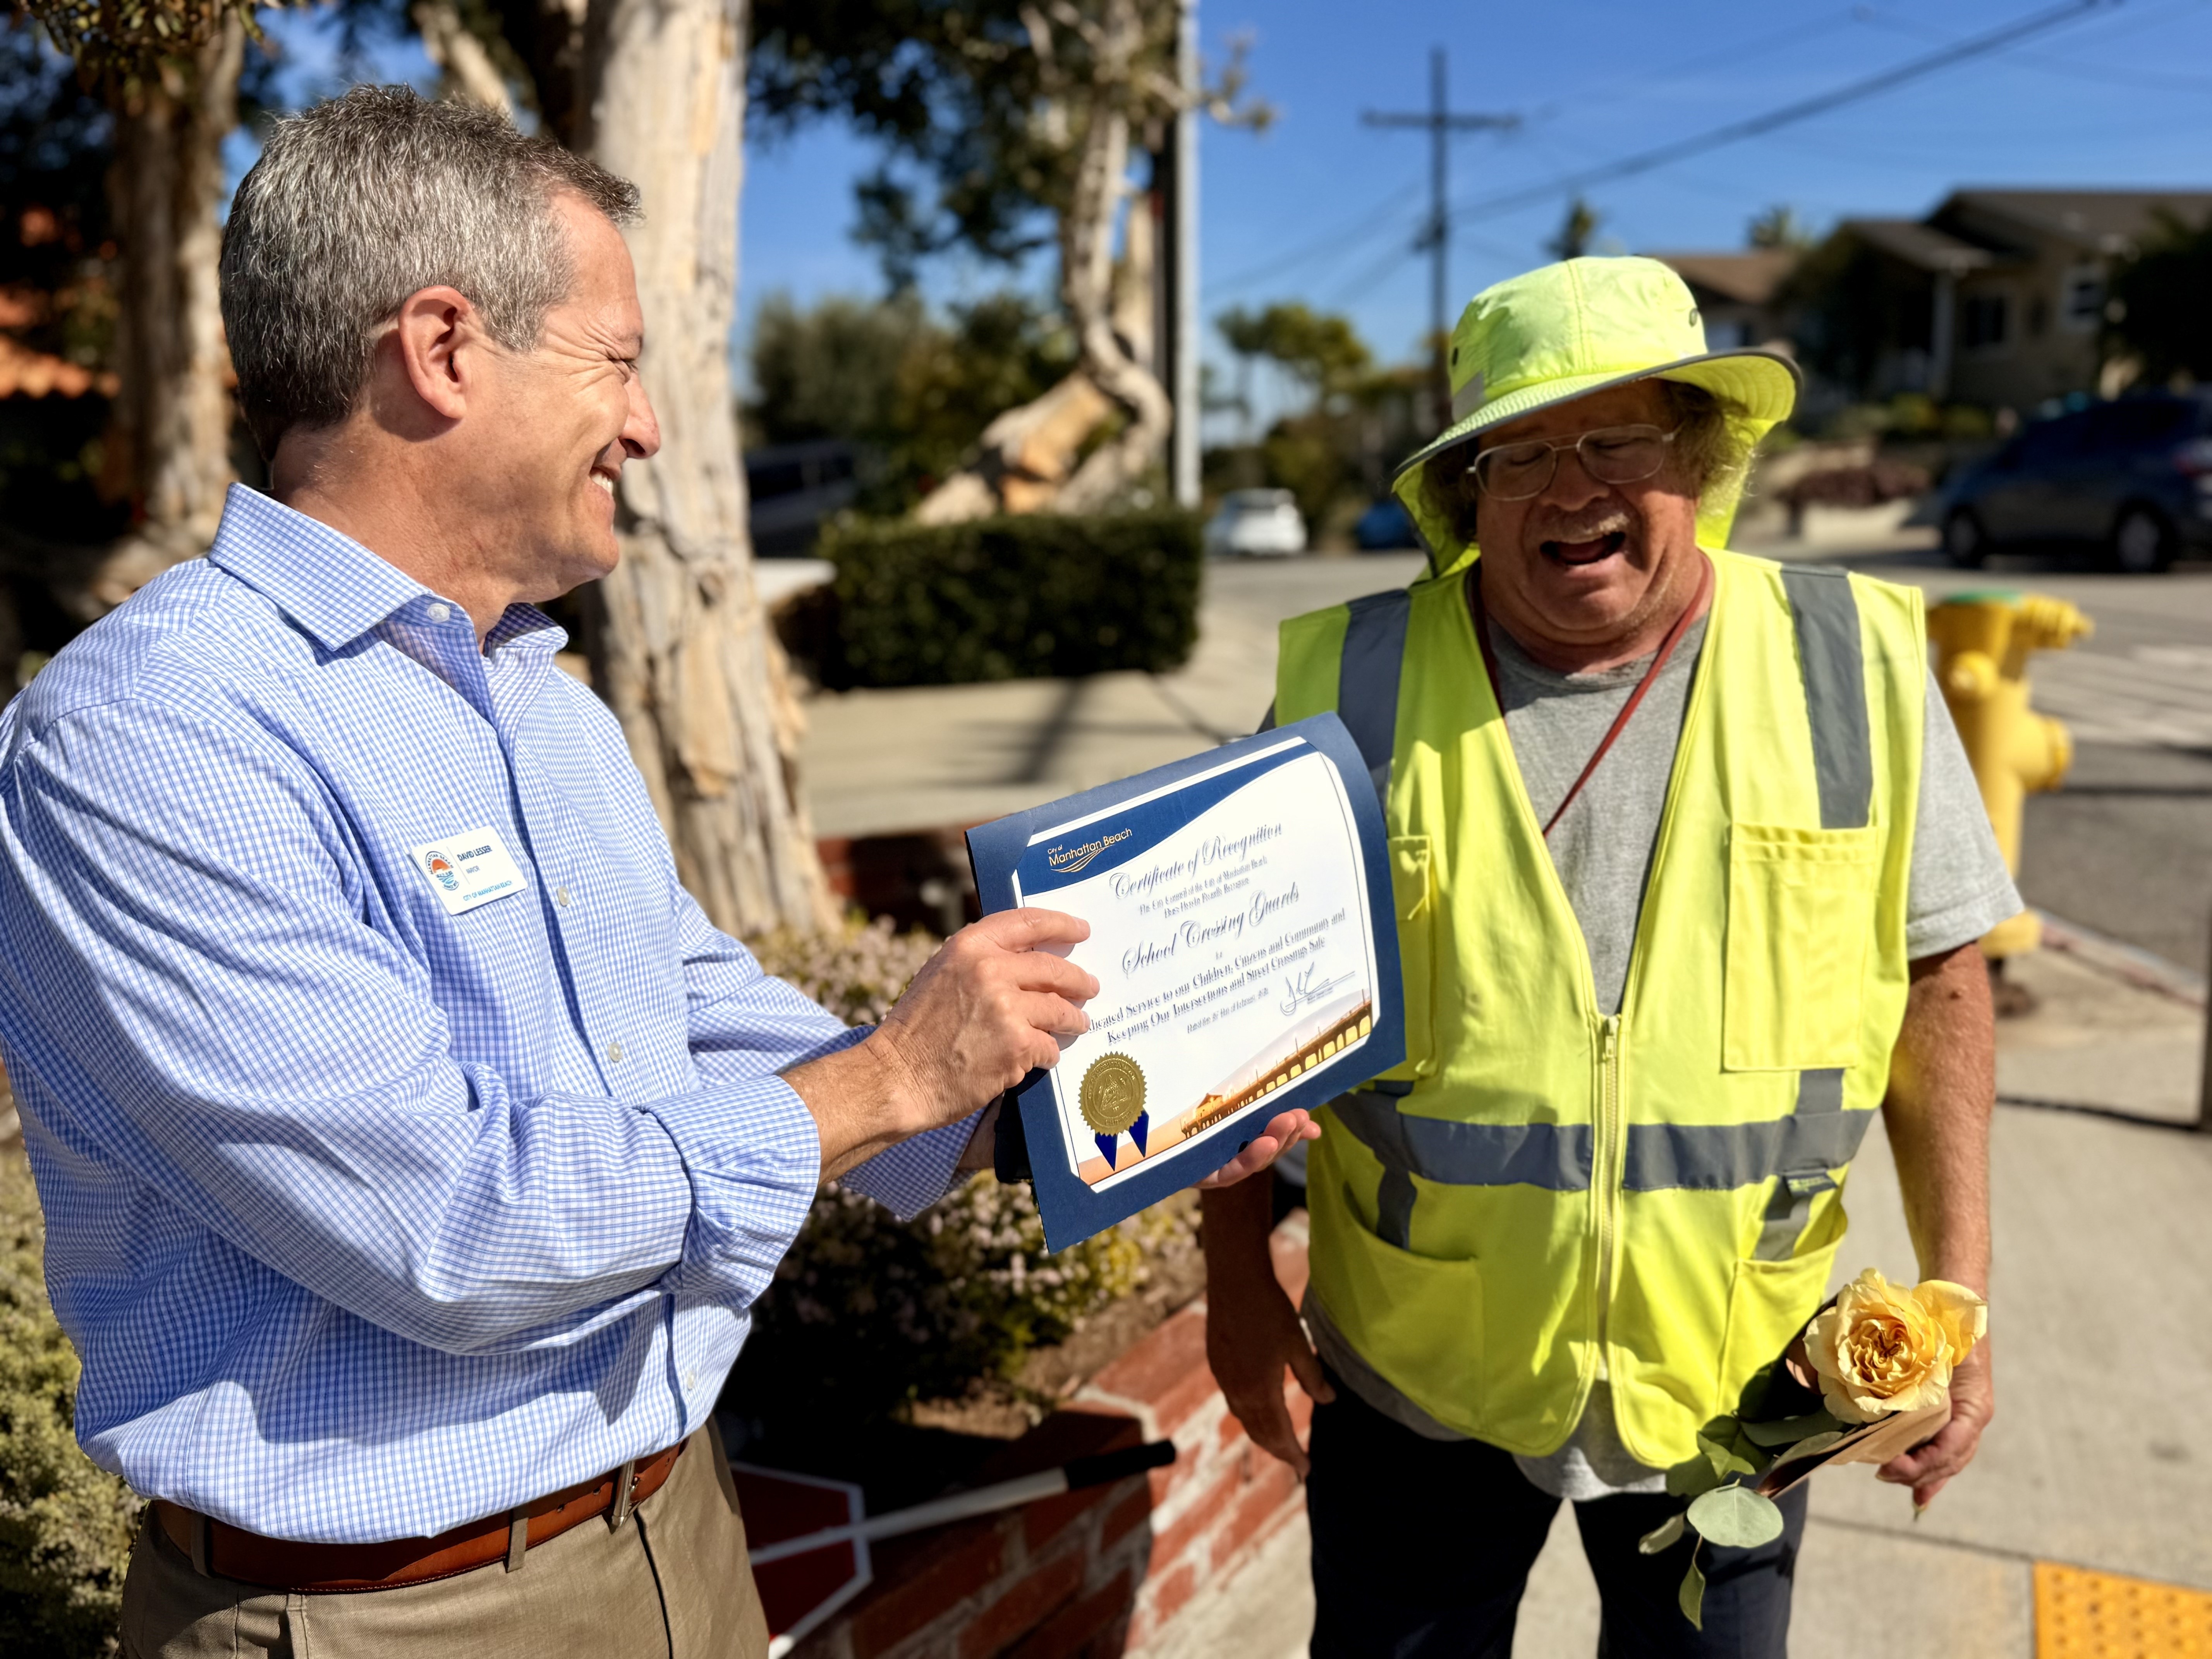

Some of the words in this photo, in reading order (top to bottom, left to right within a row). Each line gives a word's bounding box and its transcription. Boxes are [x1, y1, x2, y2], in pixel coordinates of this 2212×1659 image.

[457, 851, 475, 862] DAVID
[473, 845, 493, 856] LESSER
[1049, 840, 1102, 866] Manhattan
[1103, 828, 1133, 846] Beach
[1109, 860, 1185, 899] Certificate
[1188, 847, 1200, 880] of
[1202, 823, 1282, 865] Recognition
[1088, 1007, 1124, 1033] dicated
[1126, 994, 1160, 1018] Service
[1163, 990, 1173, 1002] to
[1175, 983, 1190, 998] our
[1193, 964, 1233, 988] Children,
[1269, 936, 1283, 956] and
[1285, 917, 1329, 946] Community
[1331, 907, 1345, 926] and
[1122, 933, 1176, 980] School
[1180, 912, 1244, 948] Crossing
[1249, 881, 1299, 927] Guards
[1107, 1020, 1149, 1046] Keeping
[1151, 1011, 1170, 1027] Our
[1173, 985, 1228, 1018] Intersections
[1230, 973, 1245, 992] and
[1246, 963, 1270, 984] Street
[1271, 943, 1308, 970] Crossings
[1309, 935, 1326, 953] Safe
